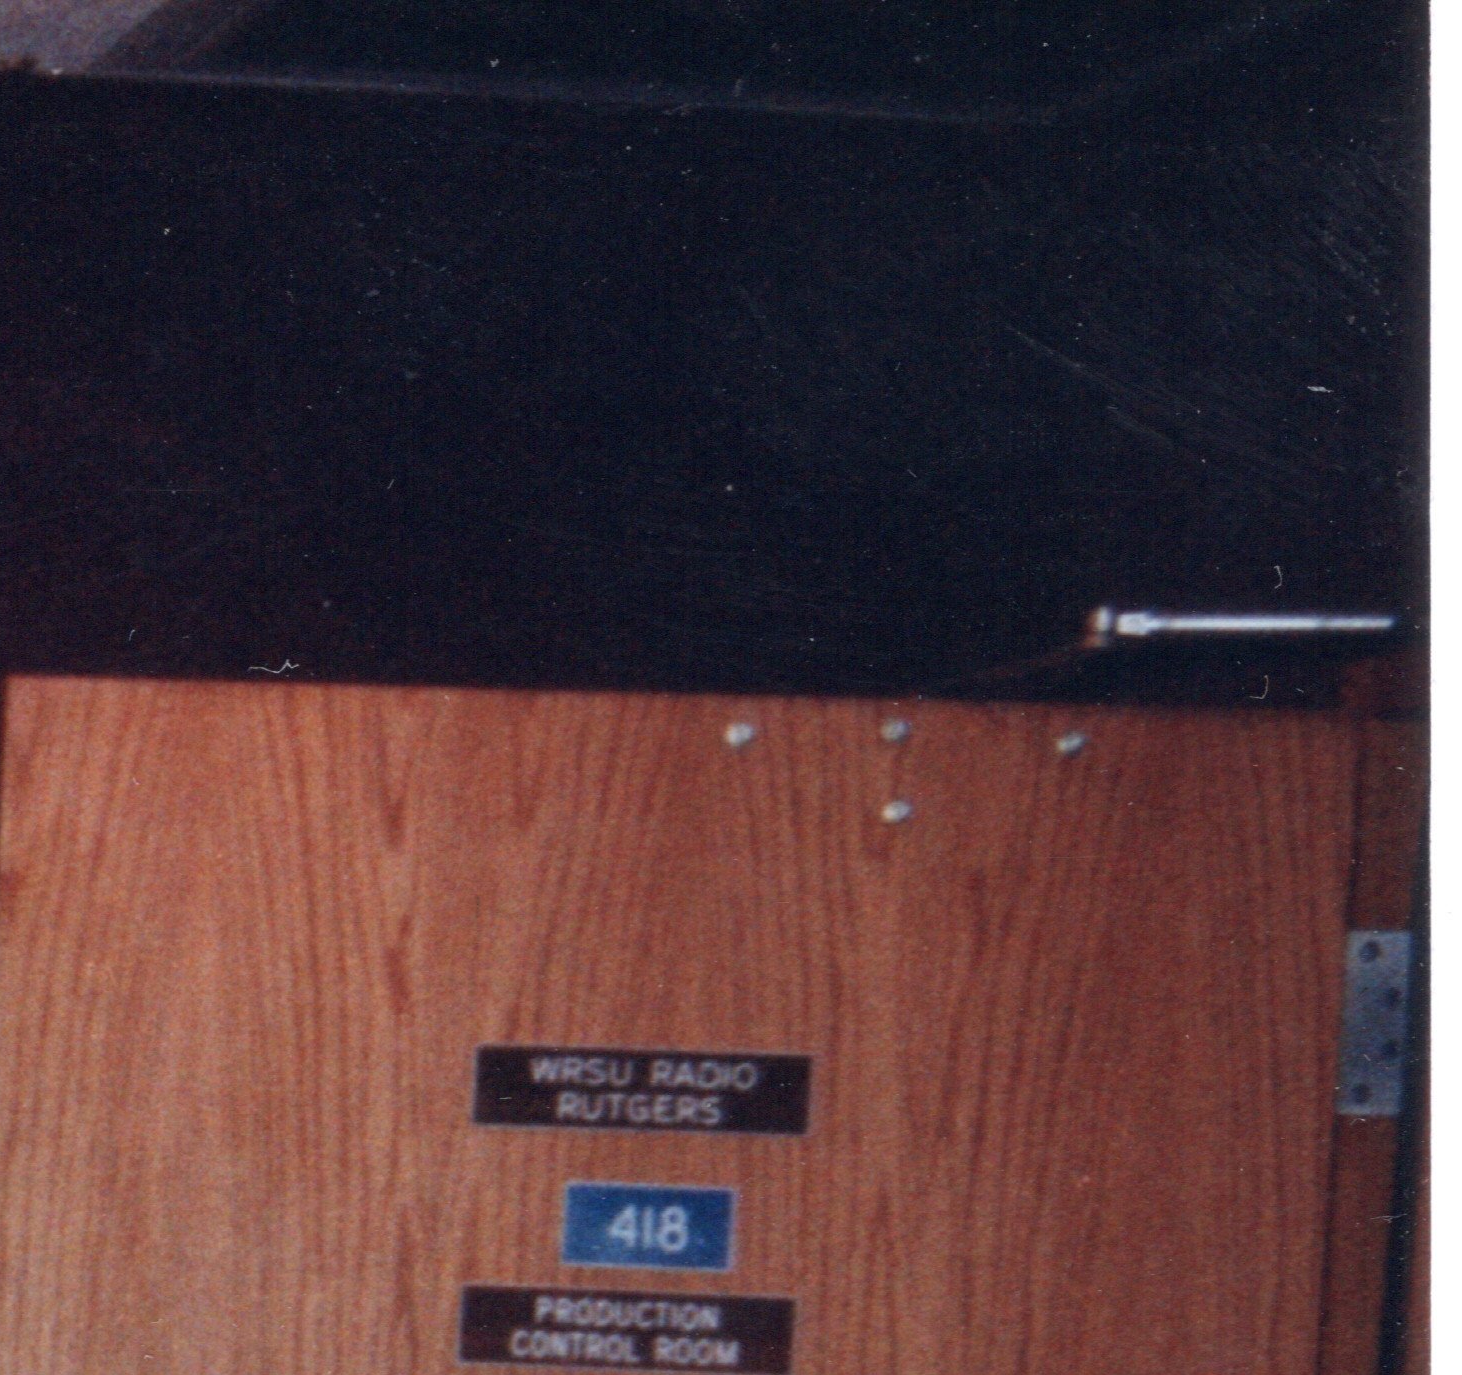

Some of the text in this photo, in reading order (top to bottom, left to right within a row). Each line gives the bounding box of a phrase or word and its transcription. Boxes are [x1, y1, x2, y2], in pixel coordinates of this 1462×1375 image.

[530, 1056, 759, 1092] WRSU RADIO
[556, 1092, 724, 1125] RUTGERS
[607, 1204, 690, 1254] 418
[534, 1297, 721, 1330] PRODUCTION
[509, 1329, 741, 1366] CONTROL ROOM
